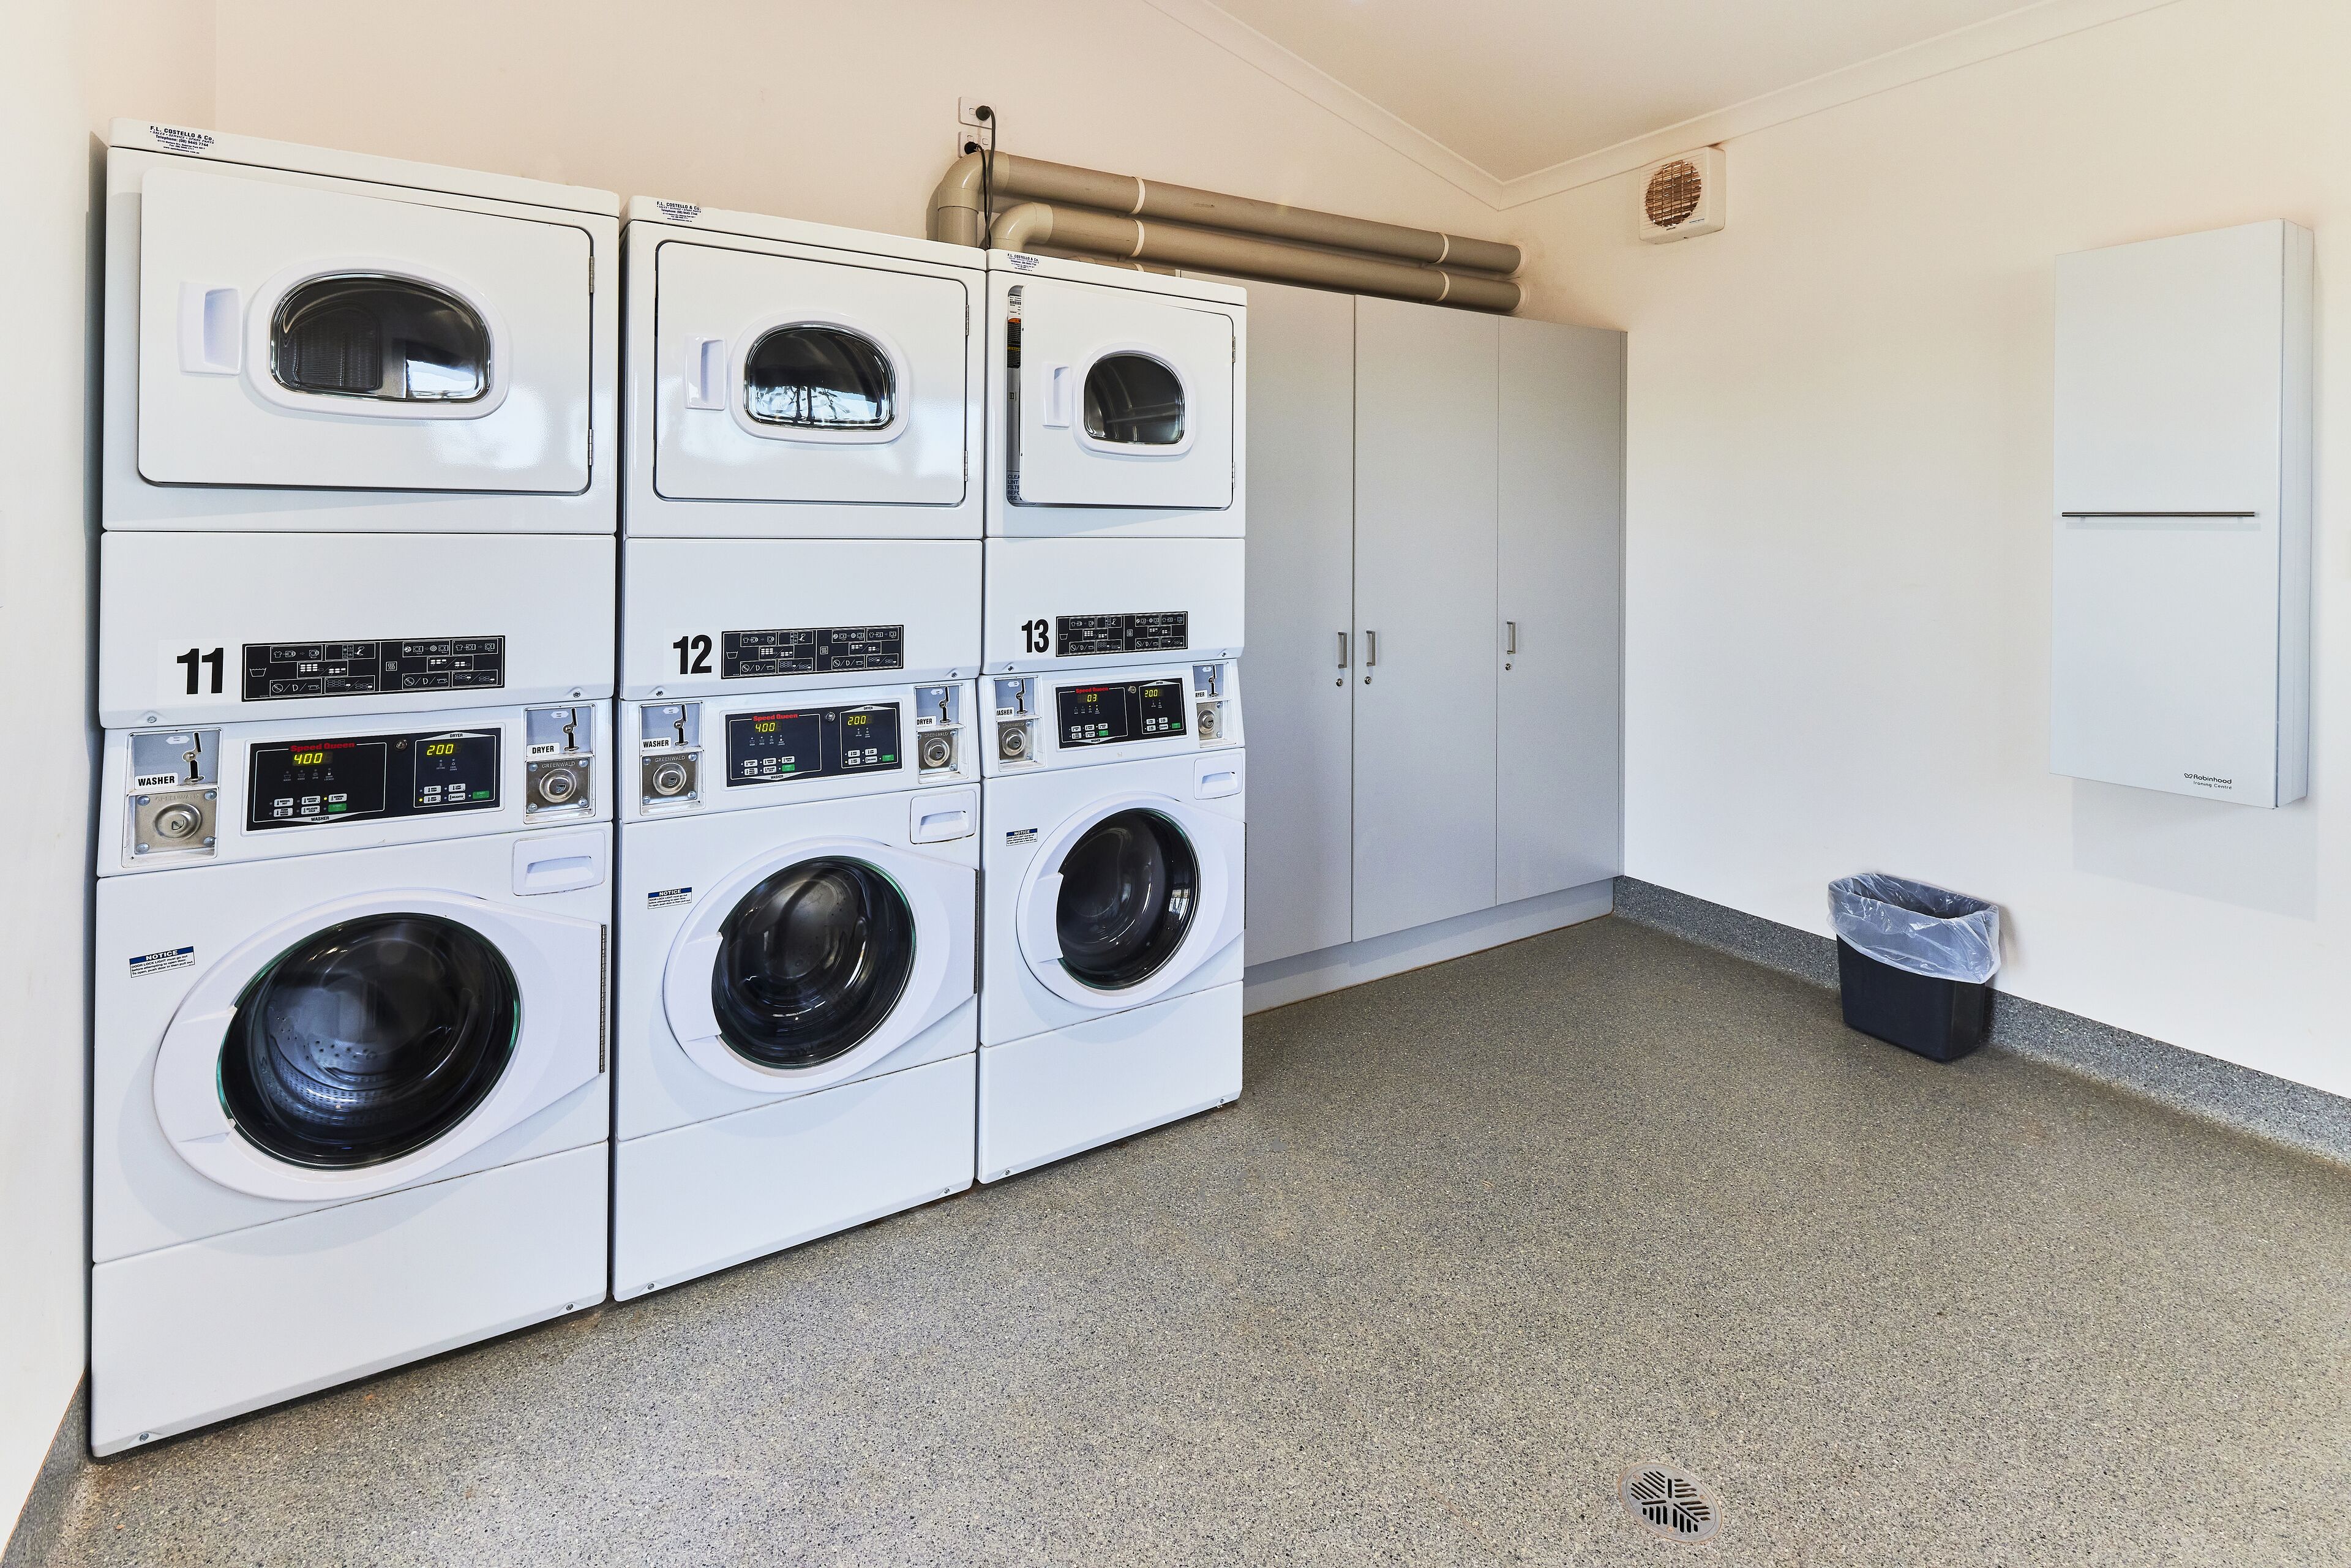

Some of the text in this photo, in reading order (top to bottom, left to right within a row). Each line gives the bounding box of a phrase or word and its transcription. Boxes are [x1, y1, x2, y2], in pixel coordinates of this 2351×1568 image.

[164, 128, 195, 138] COSTELLO
[1021, 619, 1049, 653] 13
[673, 634, 712, 675] 12
[176, 648, 223, 694] 11
[1087, 694, 1097, 702] 03
[848, 715, 866, 726] 200
[755, 722, 776, 732] 400
[290, 743, 323, 752] Speed
[643, 740, 669, 748] WASHER
[427, 744, 454, 756] 200
[532, 745, 554, 754] DRYER
[294, 752, 323, 765] 400
[138, 776, 175, 786] WASHER
[2193, 774, 2232, 784] Robinhood
[146, 950, 178, 961] NOTICE
